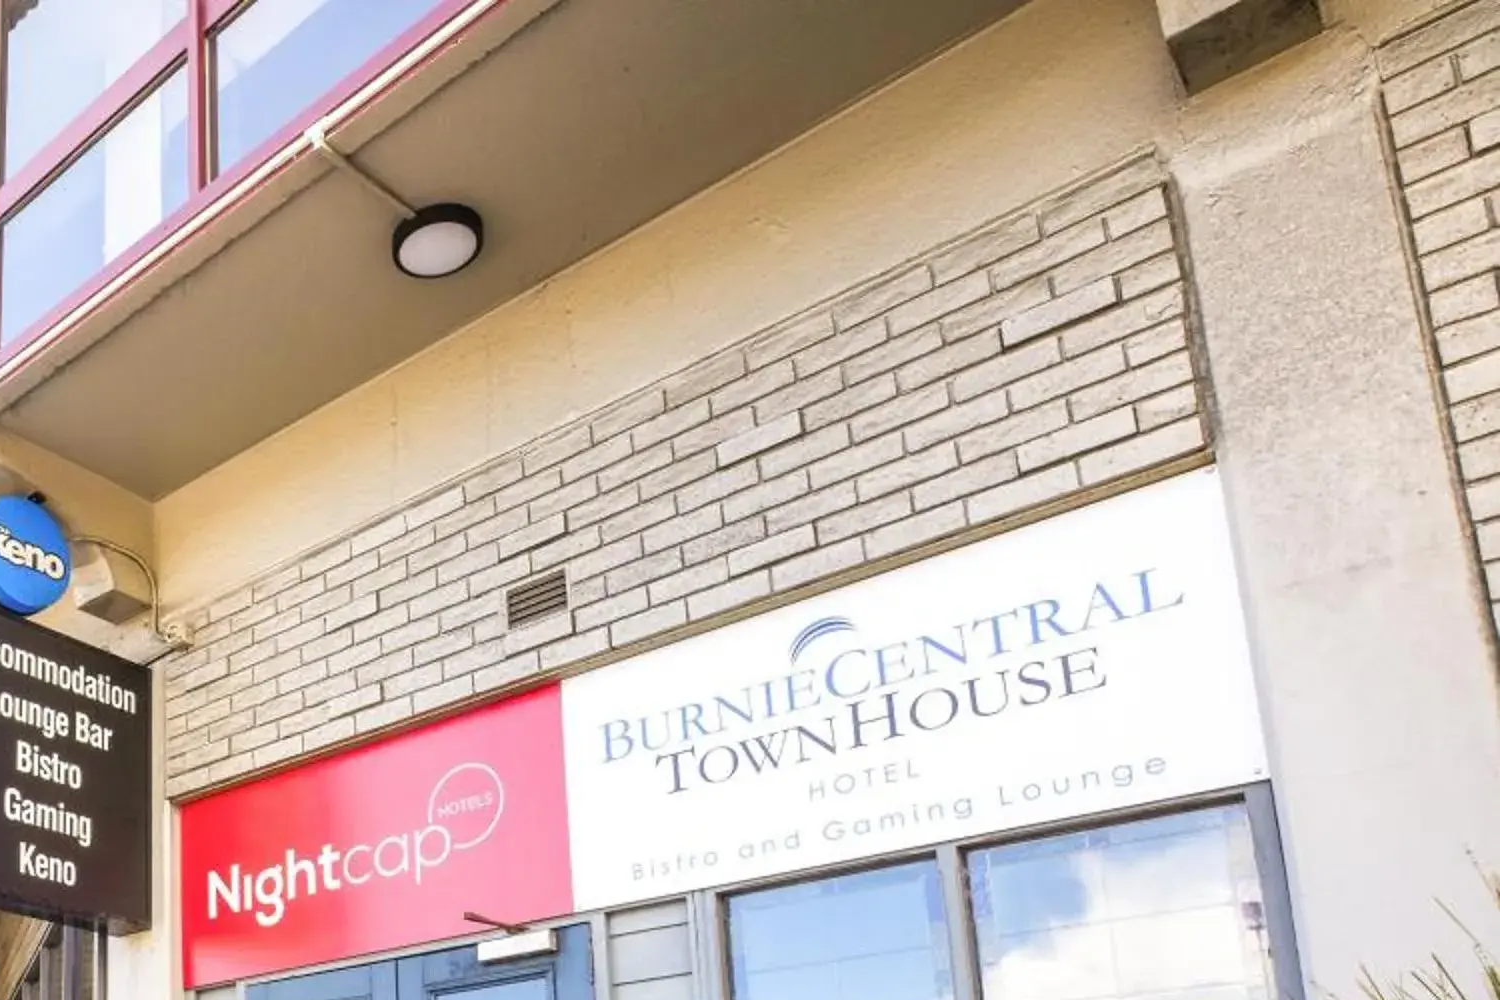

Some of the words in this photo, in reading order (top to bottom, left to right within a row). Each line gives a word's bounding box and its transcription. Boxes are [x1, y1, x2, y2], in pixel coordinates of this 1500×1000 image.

[76, 711, 113, 751] Bar
[655, 646, 1108, 795] TOWNHOUSE
[16, 739, 82, 790] Bistro
[808, 759, 921, 802] HOTEL
[4, 787, 92, 847] Gaming
[631, 849, 719, 881] Bistro
[737, 829, 800, 860] and
[821, 797, 973, 842] Gaming
[998, 756, 1167, 807] Lounge
[19, 841, 77, 887] Keno
[206, 823, 452, 927] Nightcap
